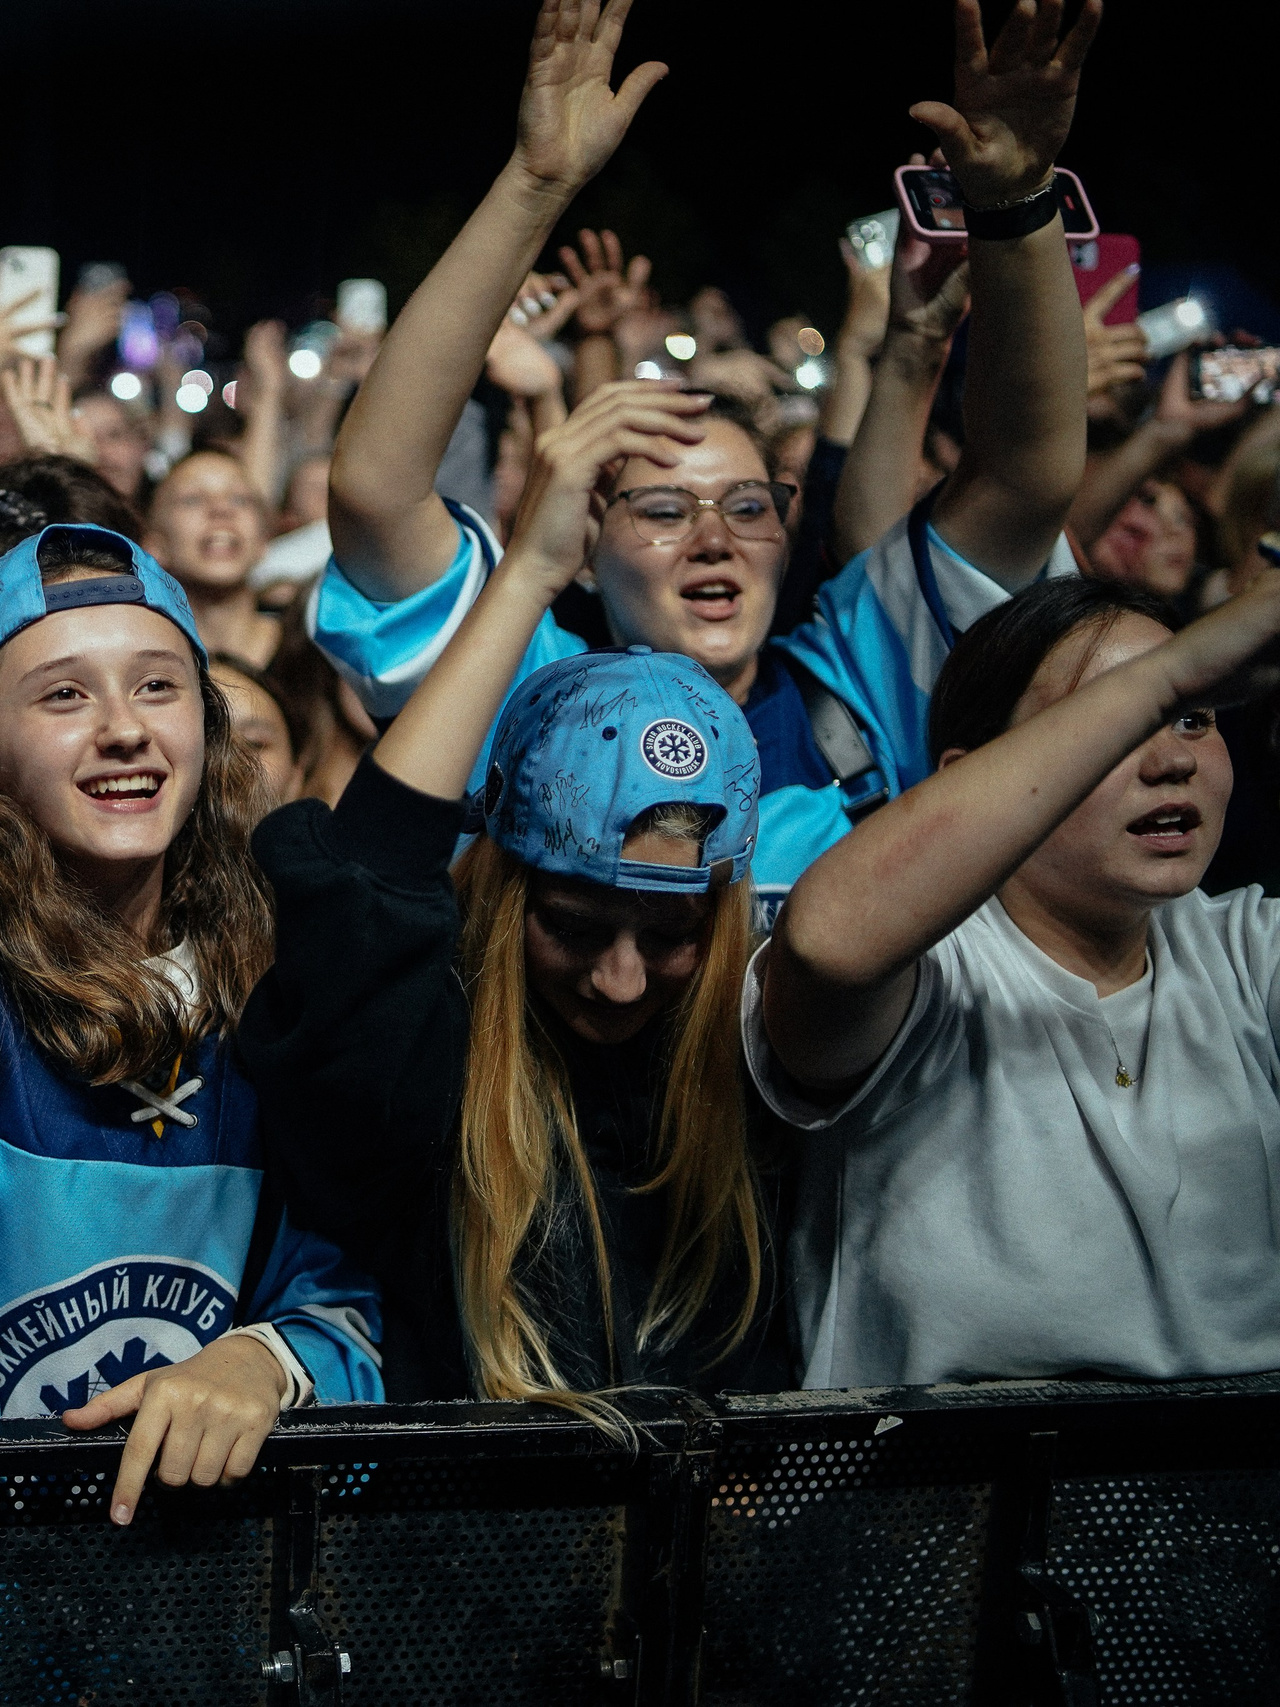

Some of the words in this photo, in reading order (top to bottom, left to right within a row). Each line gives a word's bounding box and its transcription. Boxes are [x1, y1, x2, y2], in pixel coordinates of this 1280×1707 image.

[645, 730, 658, 750] SIBIR
[656, 723, 687, 733] HOCKEY
[687, 731, 702, 750] CLUB
[655, 760, 701, 775] NOVOSIBIRSK
[142, 1274, 226, 1332] КЛУБ
